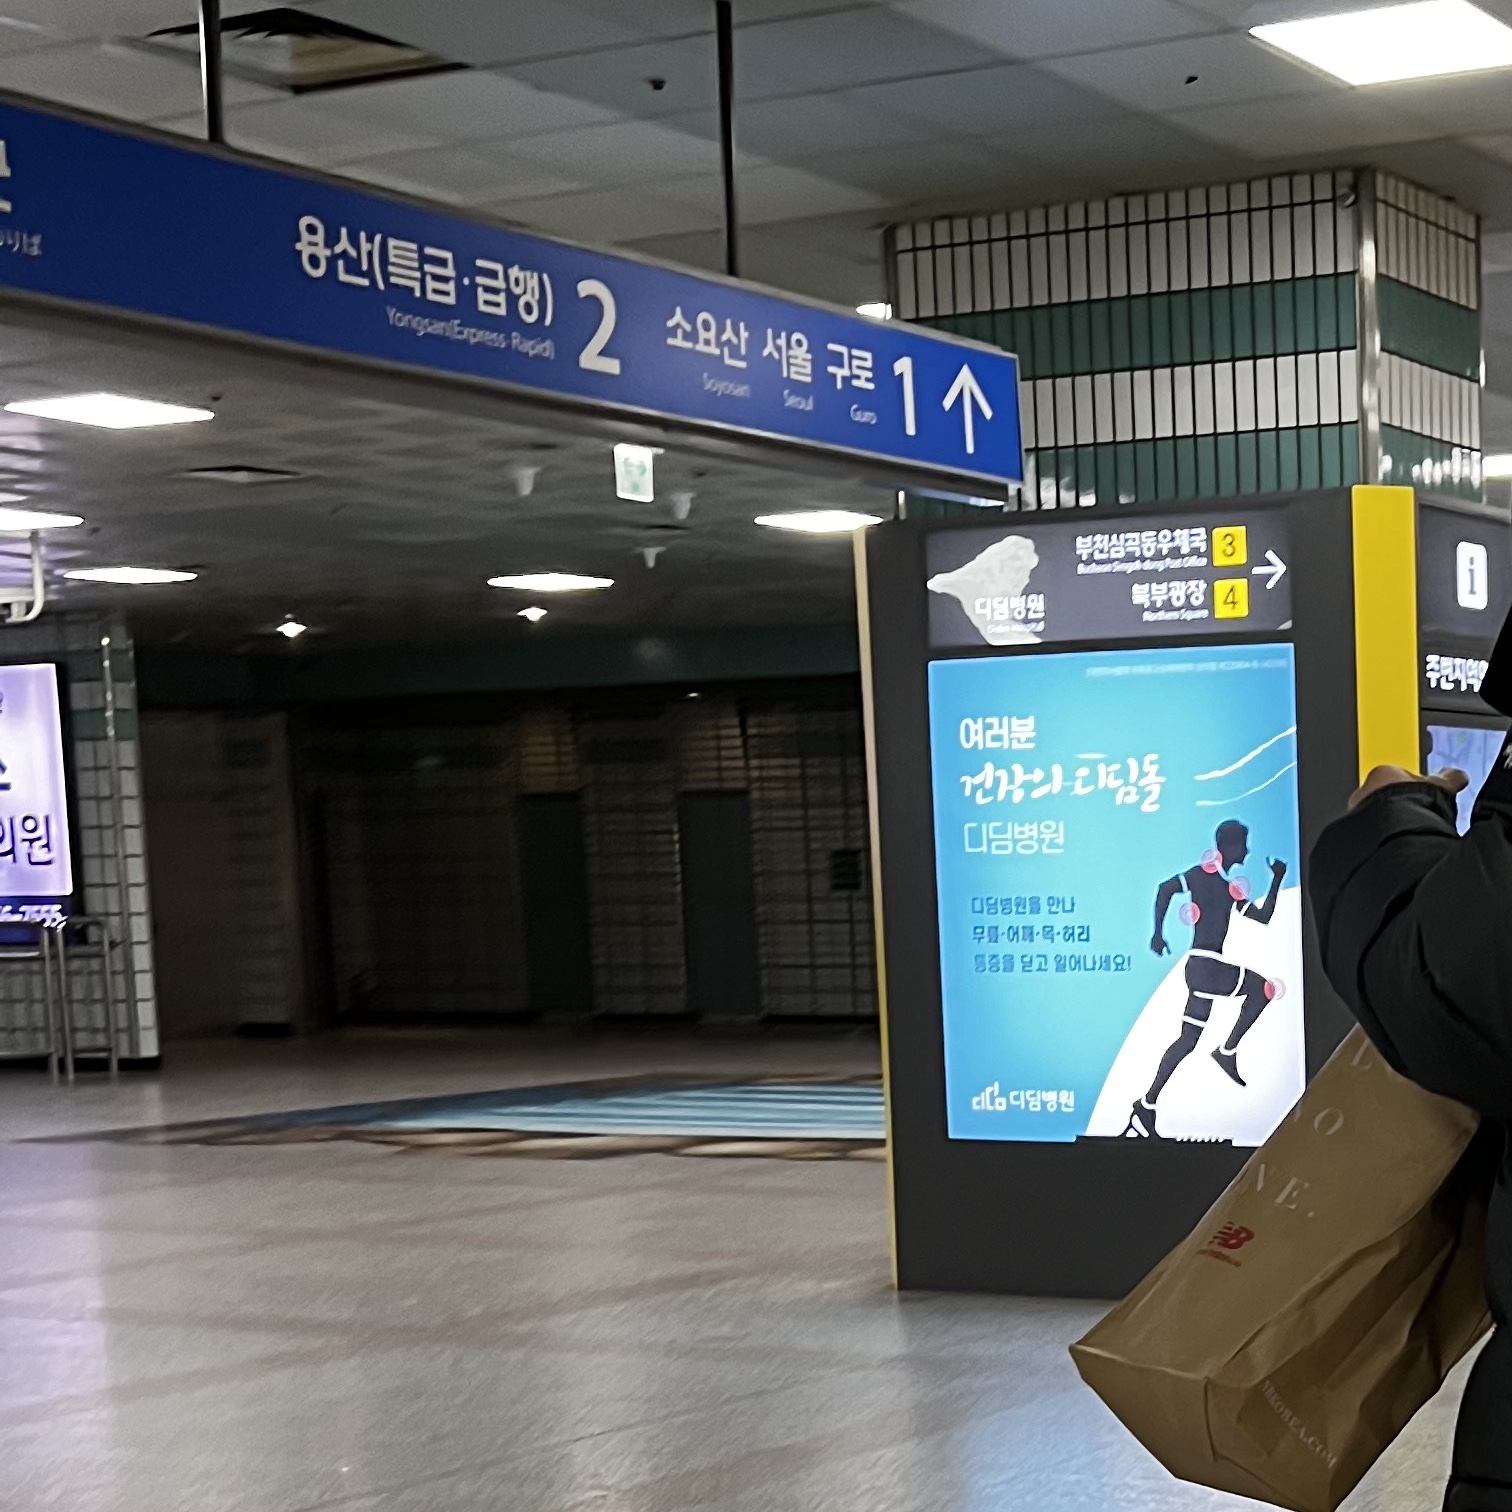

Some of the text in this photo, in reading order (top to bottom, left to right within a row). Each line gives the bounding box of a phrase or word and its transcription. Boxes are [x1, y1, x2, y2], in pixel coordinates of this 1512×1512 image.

[295, 215, 916, 437] 용산(특급·급행) 2 소요산 서울 구로 1
[1222, 533, 1235, 558] 3
[975, 593, 1045, 621] 디딤병원
[1131, 579, 1239, 610] 북부광장 4
[959, 715, 1036, 750] 여러분
[960, 761, 1062, 805] 건강의
[963, 820, 1065, 855] 디딤병원
[1047, 896, 1076, 914] 만나
[1009, 1090, 1076, 1113] 디딤병원
